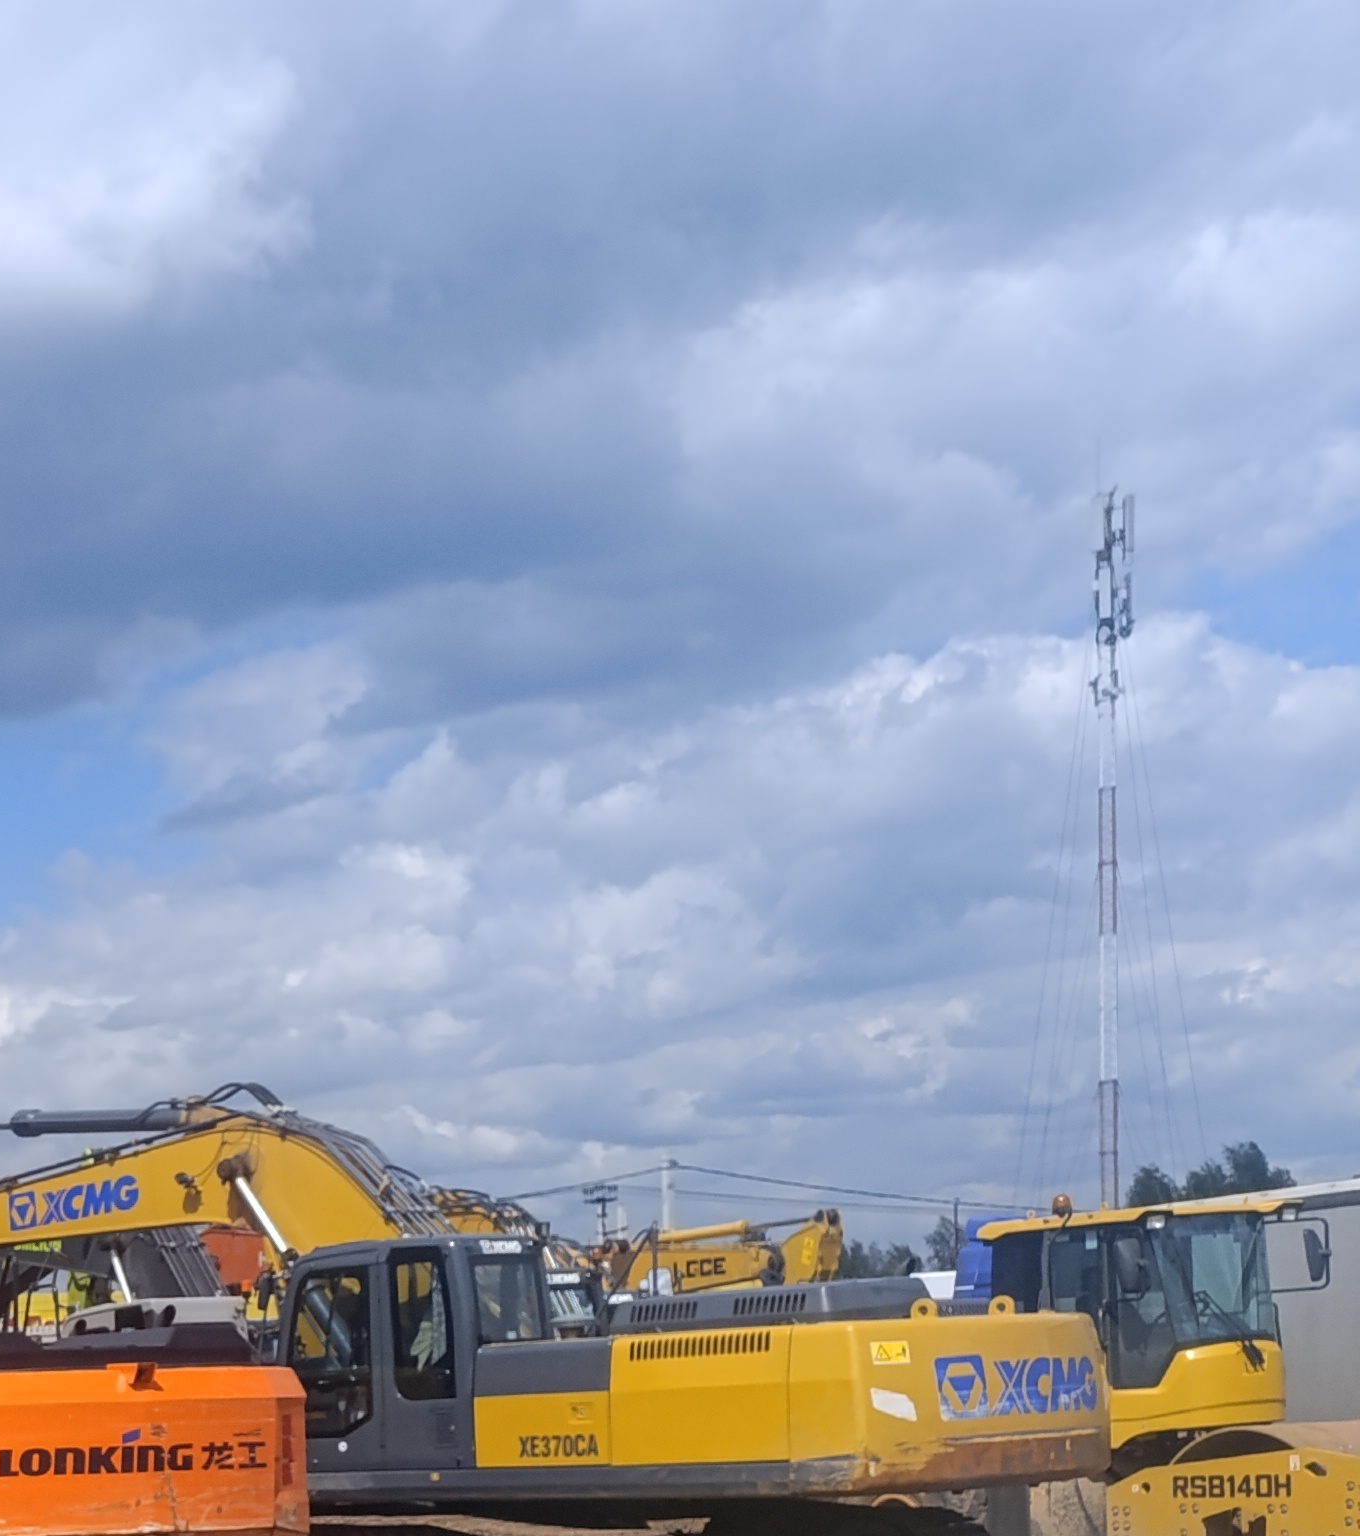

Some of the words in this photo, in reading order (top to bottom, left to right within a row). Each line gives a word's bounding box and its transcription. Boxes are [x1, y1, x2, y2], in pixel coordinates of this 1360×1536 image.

[41, 1175, 139, 1225] XCMG
[991, 1356, 1097, 1415] XCMG
[519, 1434, 599, 1457] XE370CA
[1172, 1474, 1291, 1498] RSB140H
